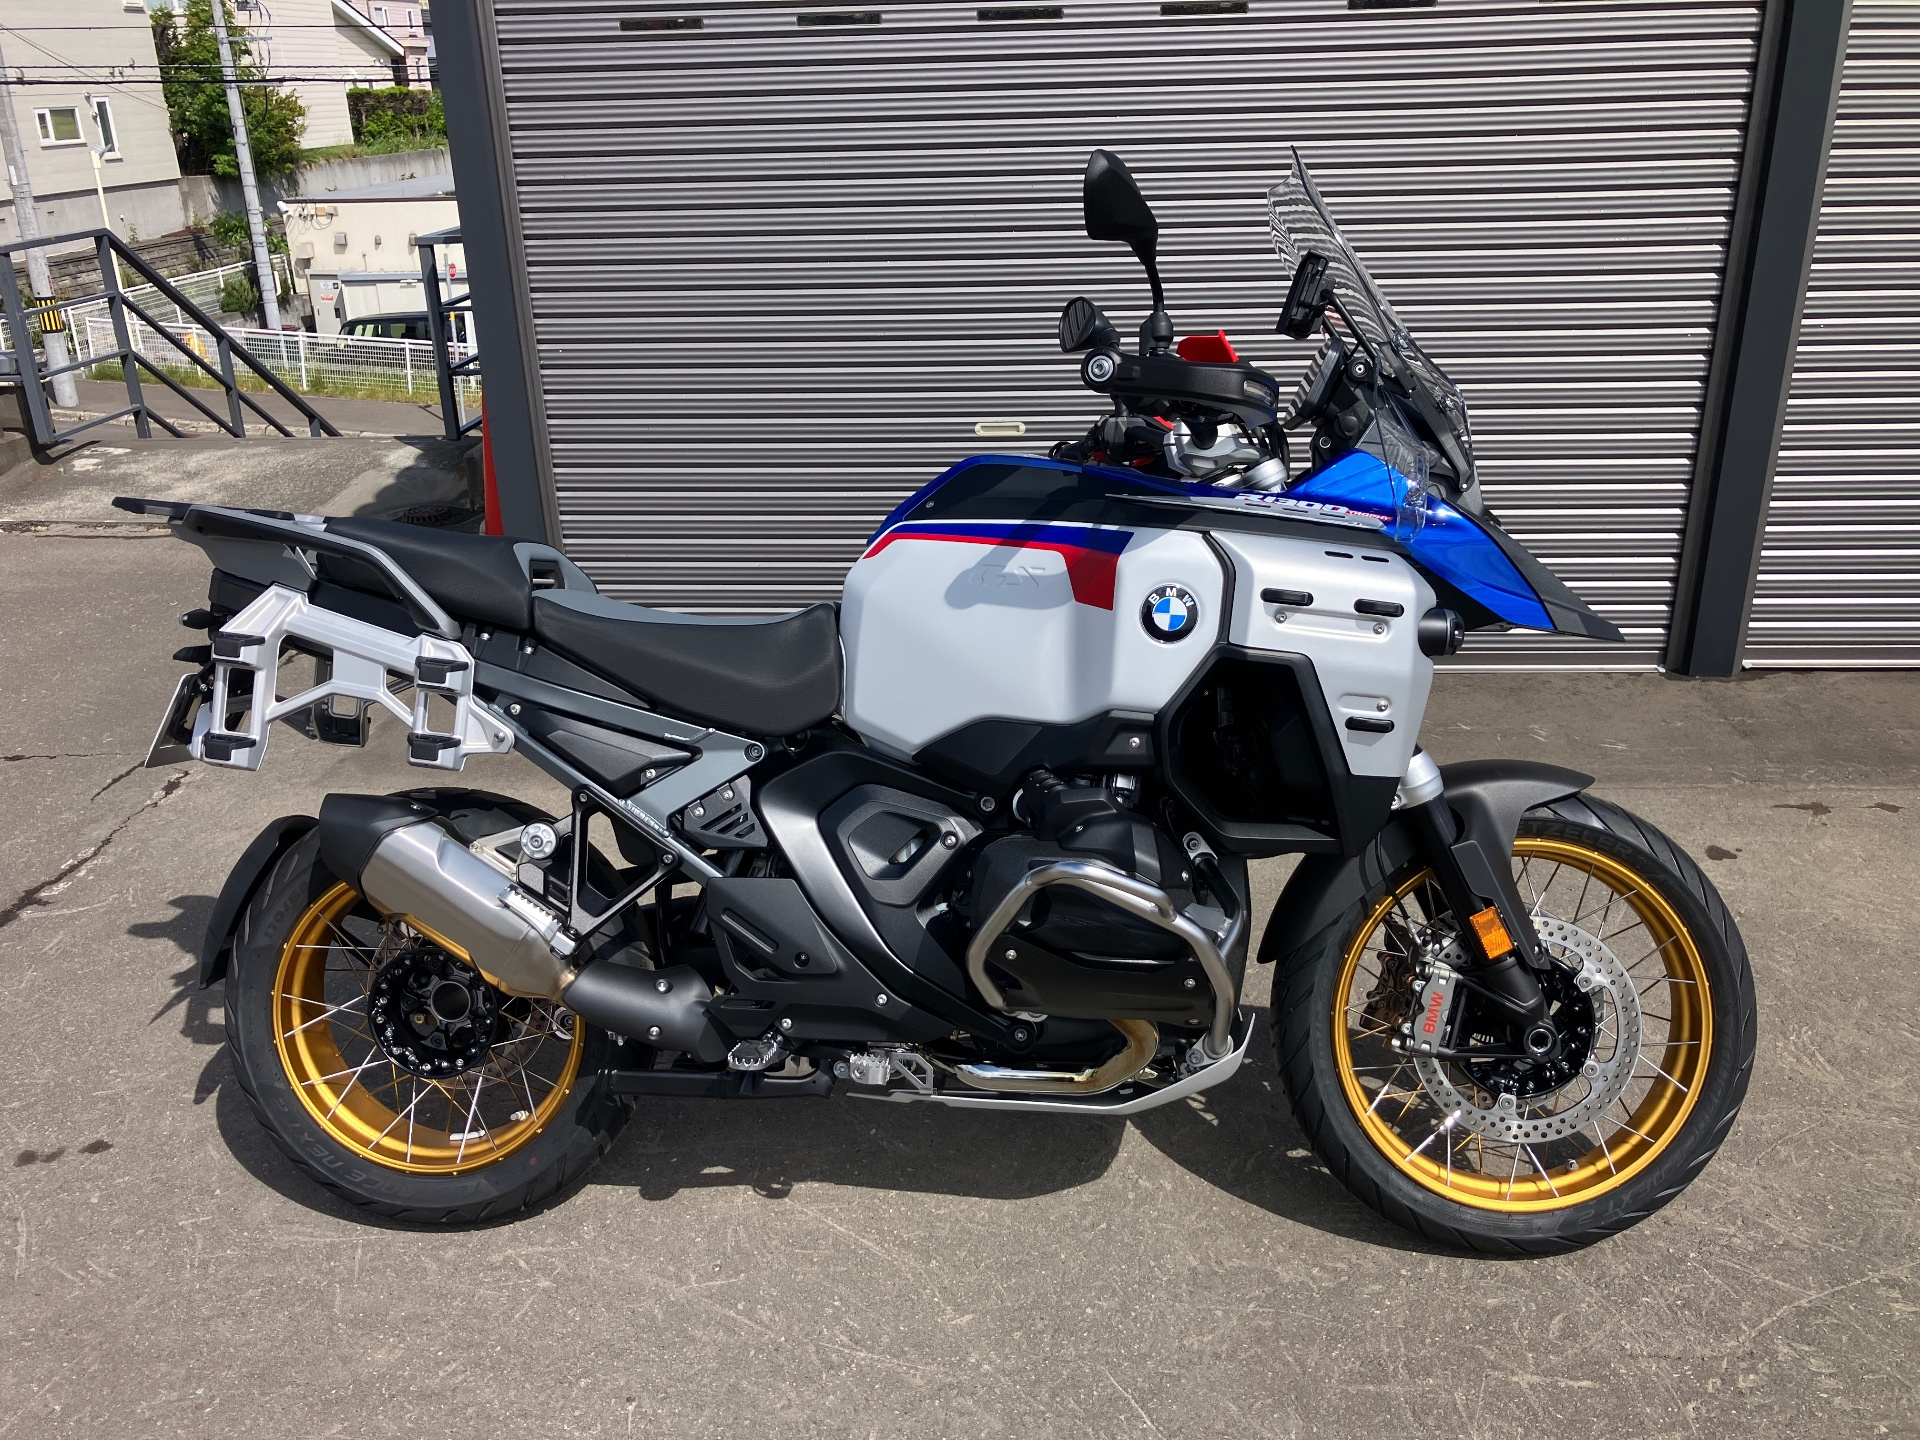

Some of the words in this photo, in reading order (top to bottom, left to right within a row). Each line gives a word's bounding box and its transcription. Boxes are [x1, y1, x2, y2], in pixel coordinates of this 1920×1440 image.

[1148, 587, 1194, 607] BMW
[1518, 820, 1634, 861] ETZELER
[1422, 990, 1444, 1035] BMW
[282, 1112, 345, 1174] NEXT
